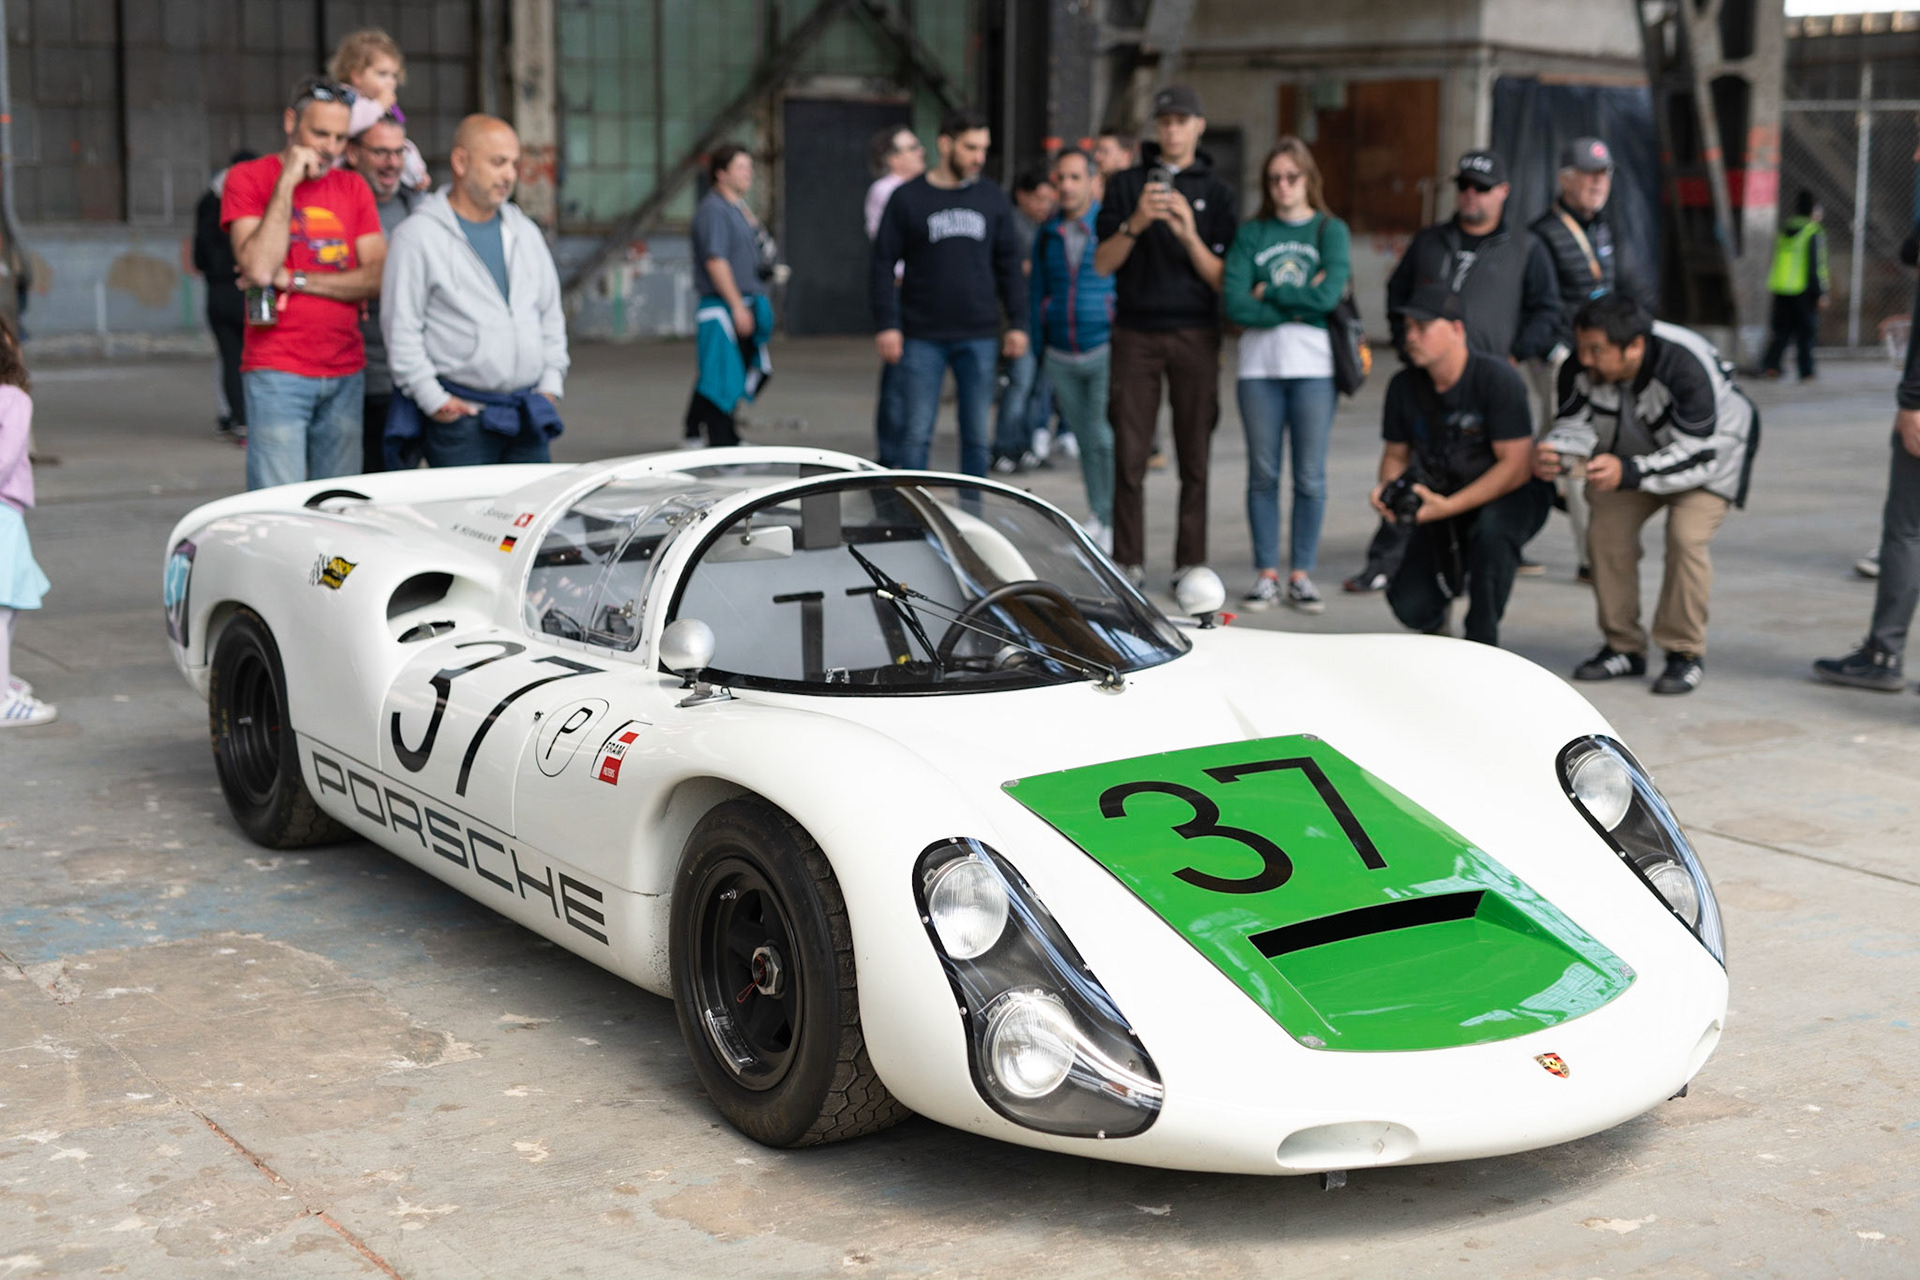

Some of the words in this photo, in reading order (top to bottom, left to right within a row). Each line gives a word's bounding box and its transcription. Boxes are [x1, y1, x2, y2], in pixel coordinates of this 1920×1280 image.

[390, 640, 608, 798] 37
[603, 741, 626, 756] FRAM
[312, 750, 610, 947] PORSCHE
[1098, 756, 1389, 894] 37
